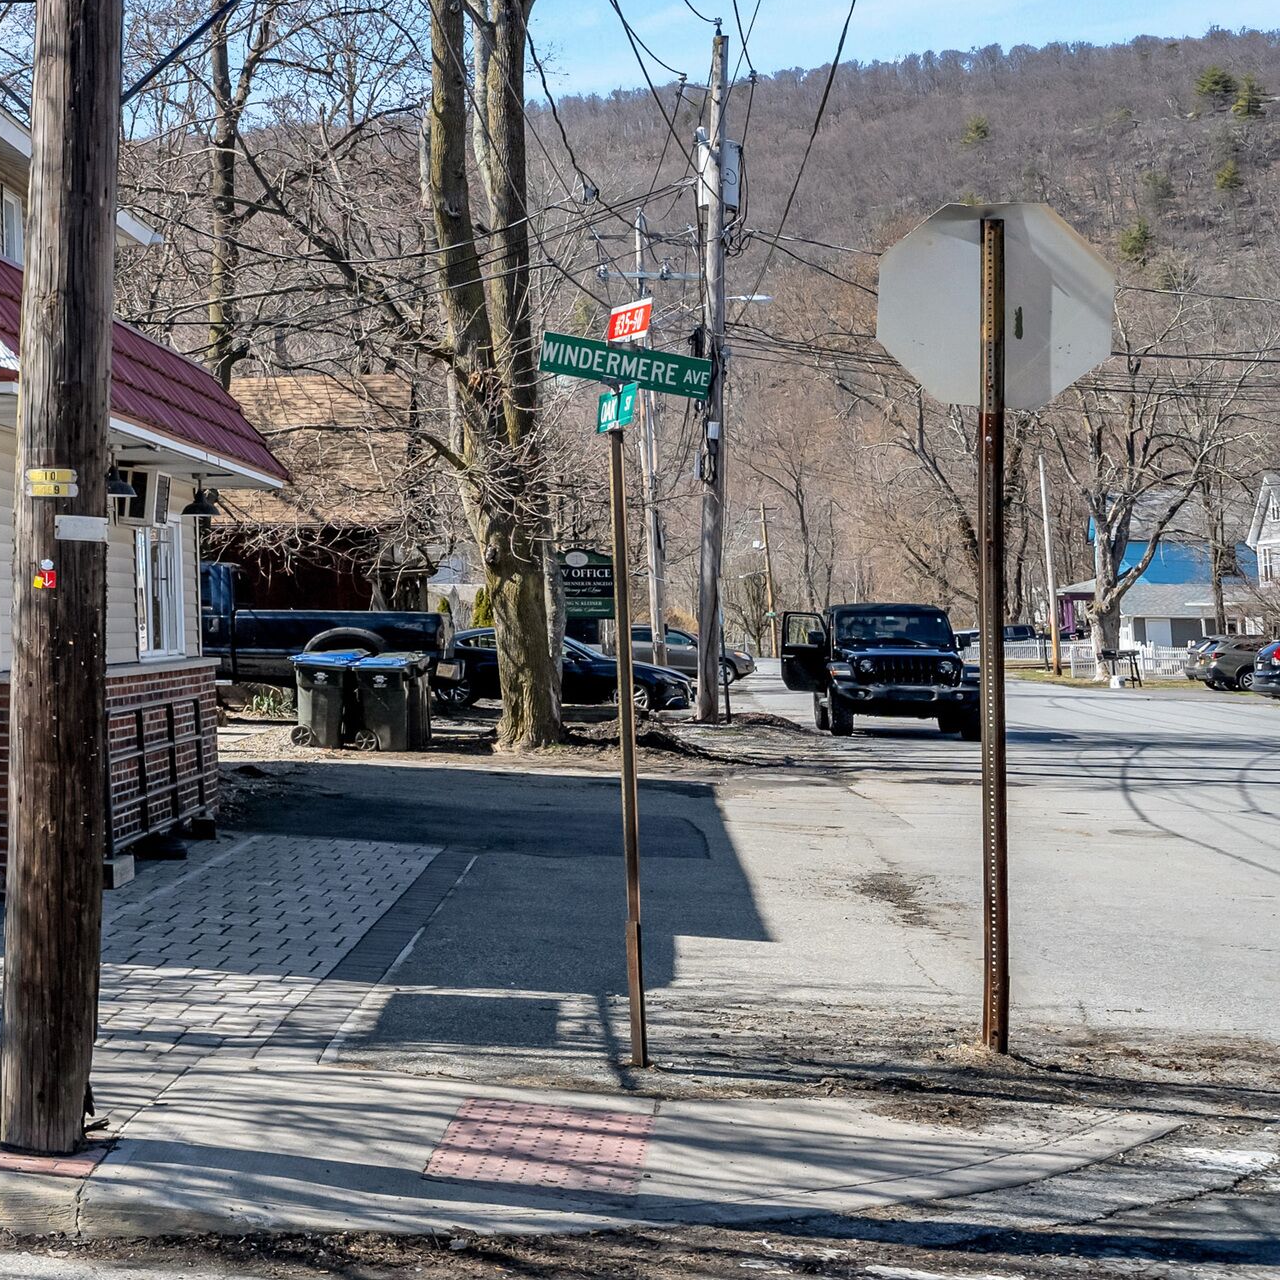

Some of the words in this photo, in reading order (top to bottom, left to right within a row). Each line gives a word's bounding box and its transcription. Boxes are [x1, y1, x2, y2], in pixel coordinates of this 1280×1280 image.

[542, 339, 679, 386] WINDERMERE
[683, 369, 710, 387] AVE
[601, 400, 617, 424] OAK
[571, 568, 612, 578] OFFICE
